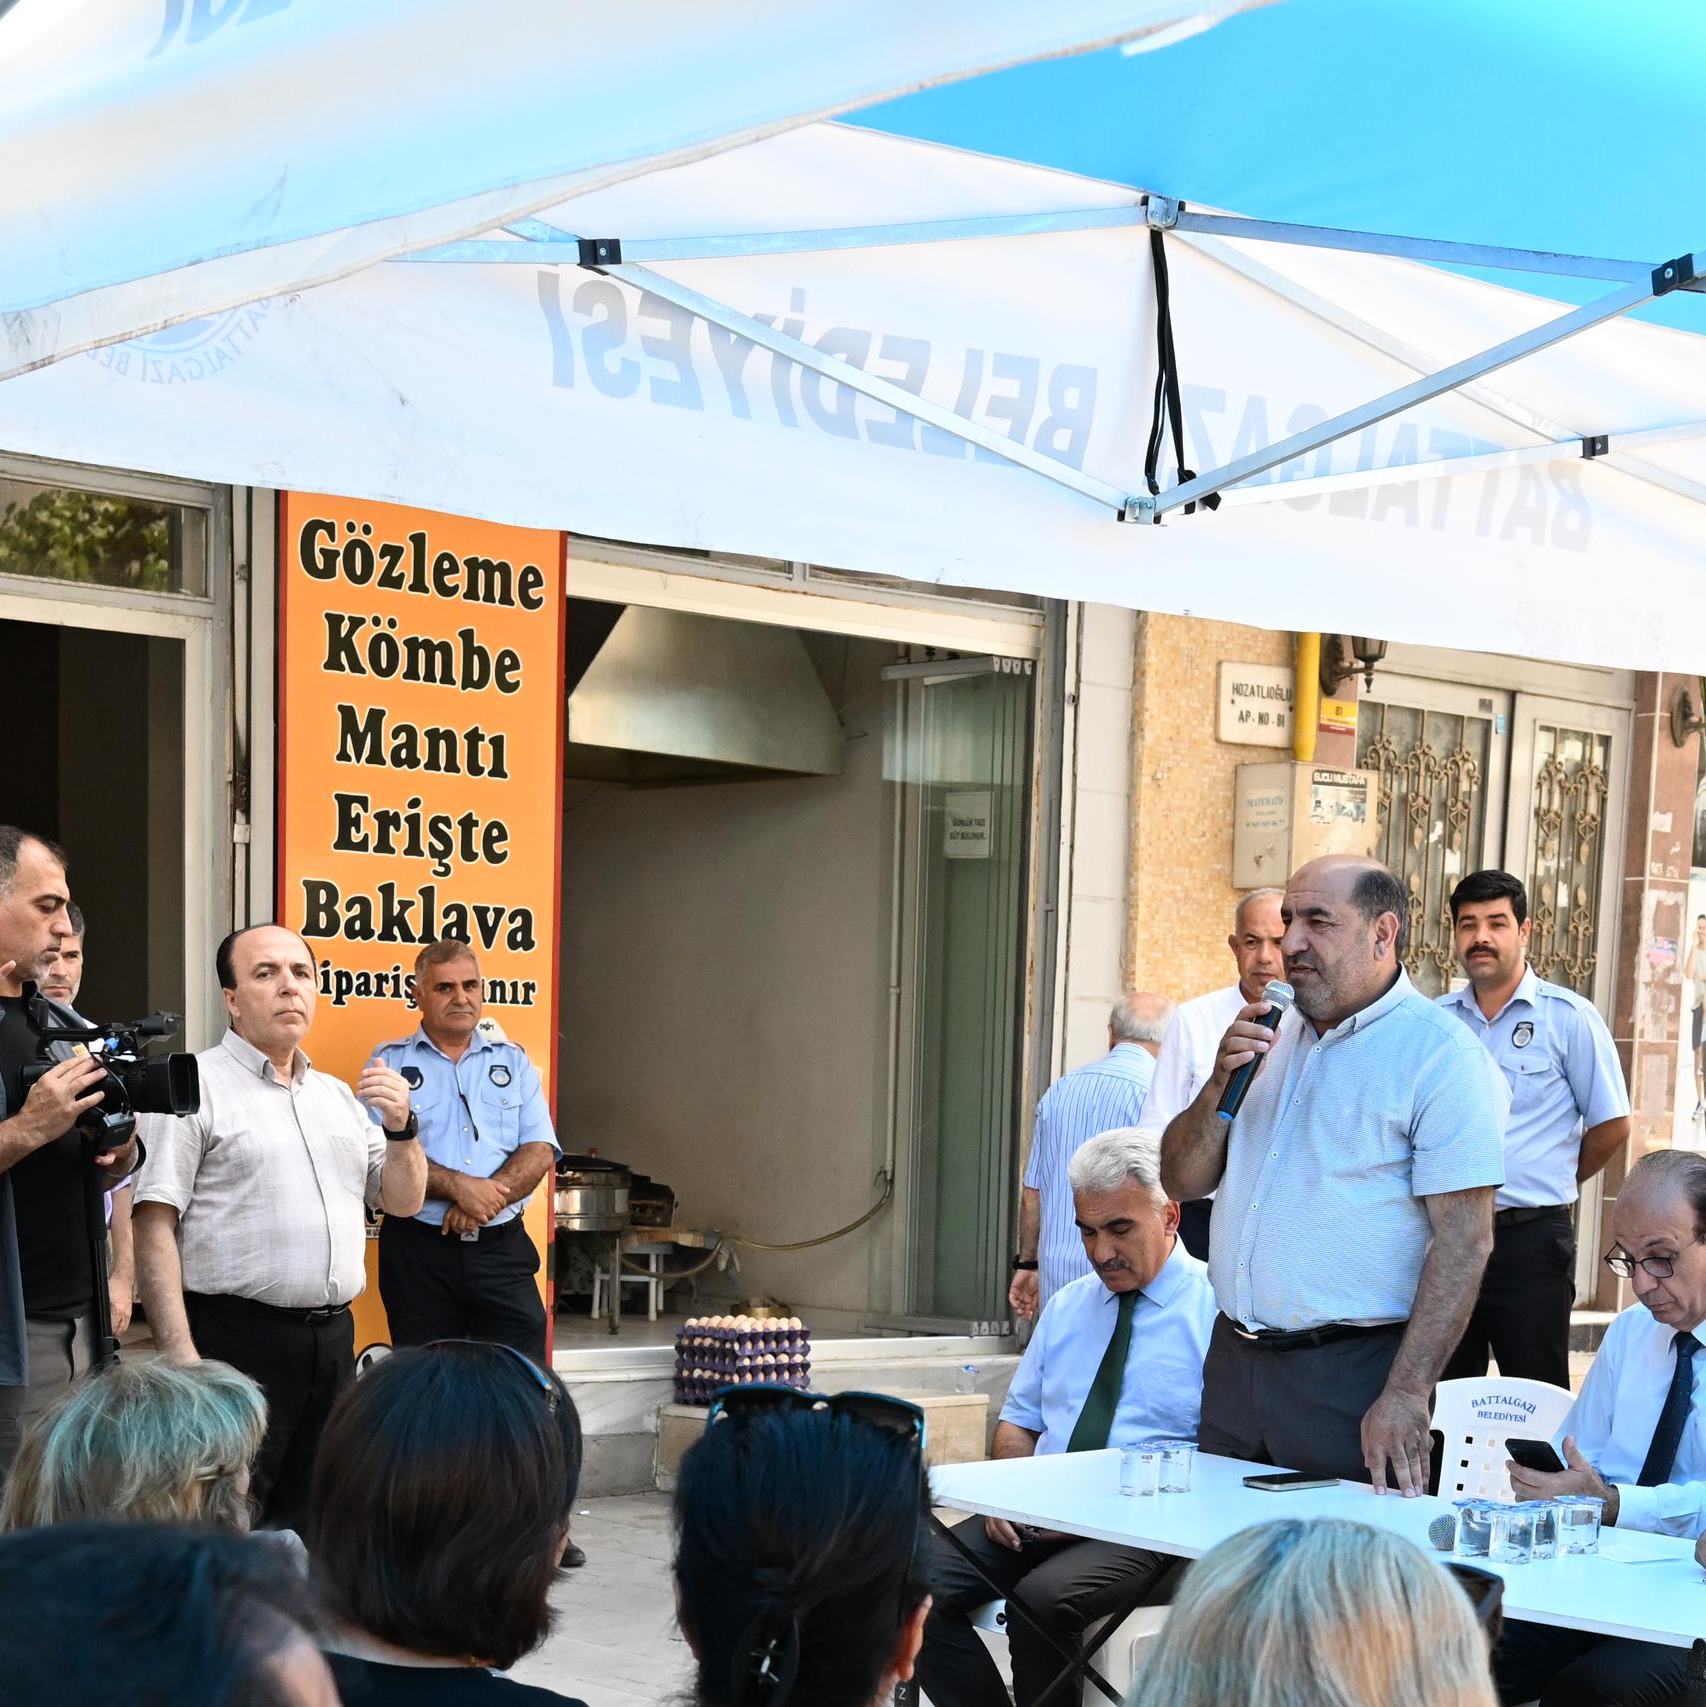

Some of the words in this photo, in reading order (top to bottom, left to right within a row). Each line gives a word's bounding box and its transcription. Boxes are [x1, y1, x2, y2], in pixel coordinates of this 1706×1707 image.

[299, 518, 545, 612] Gözleme
[322, 611, 522, 694] Kömbe
[335, 703, 509, 780] Mantı
[332, 791, 510, 878] Erişte
[301, 879, 536, 951] Baklava
[317, 958, 420, 1010] ipariş
[1471, 1395, 1537, 1414] BATTALGAZİ
[1477, 1410, 1527, 1423] BELEDİYESİ
